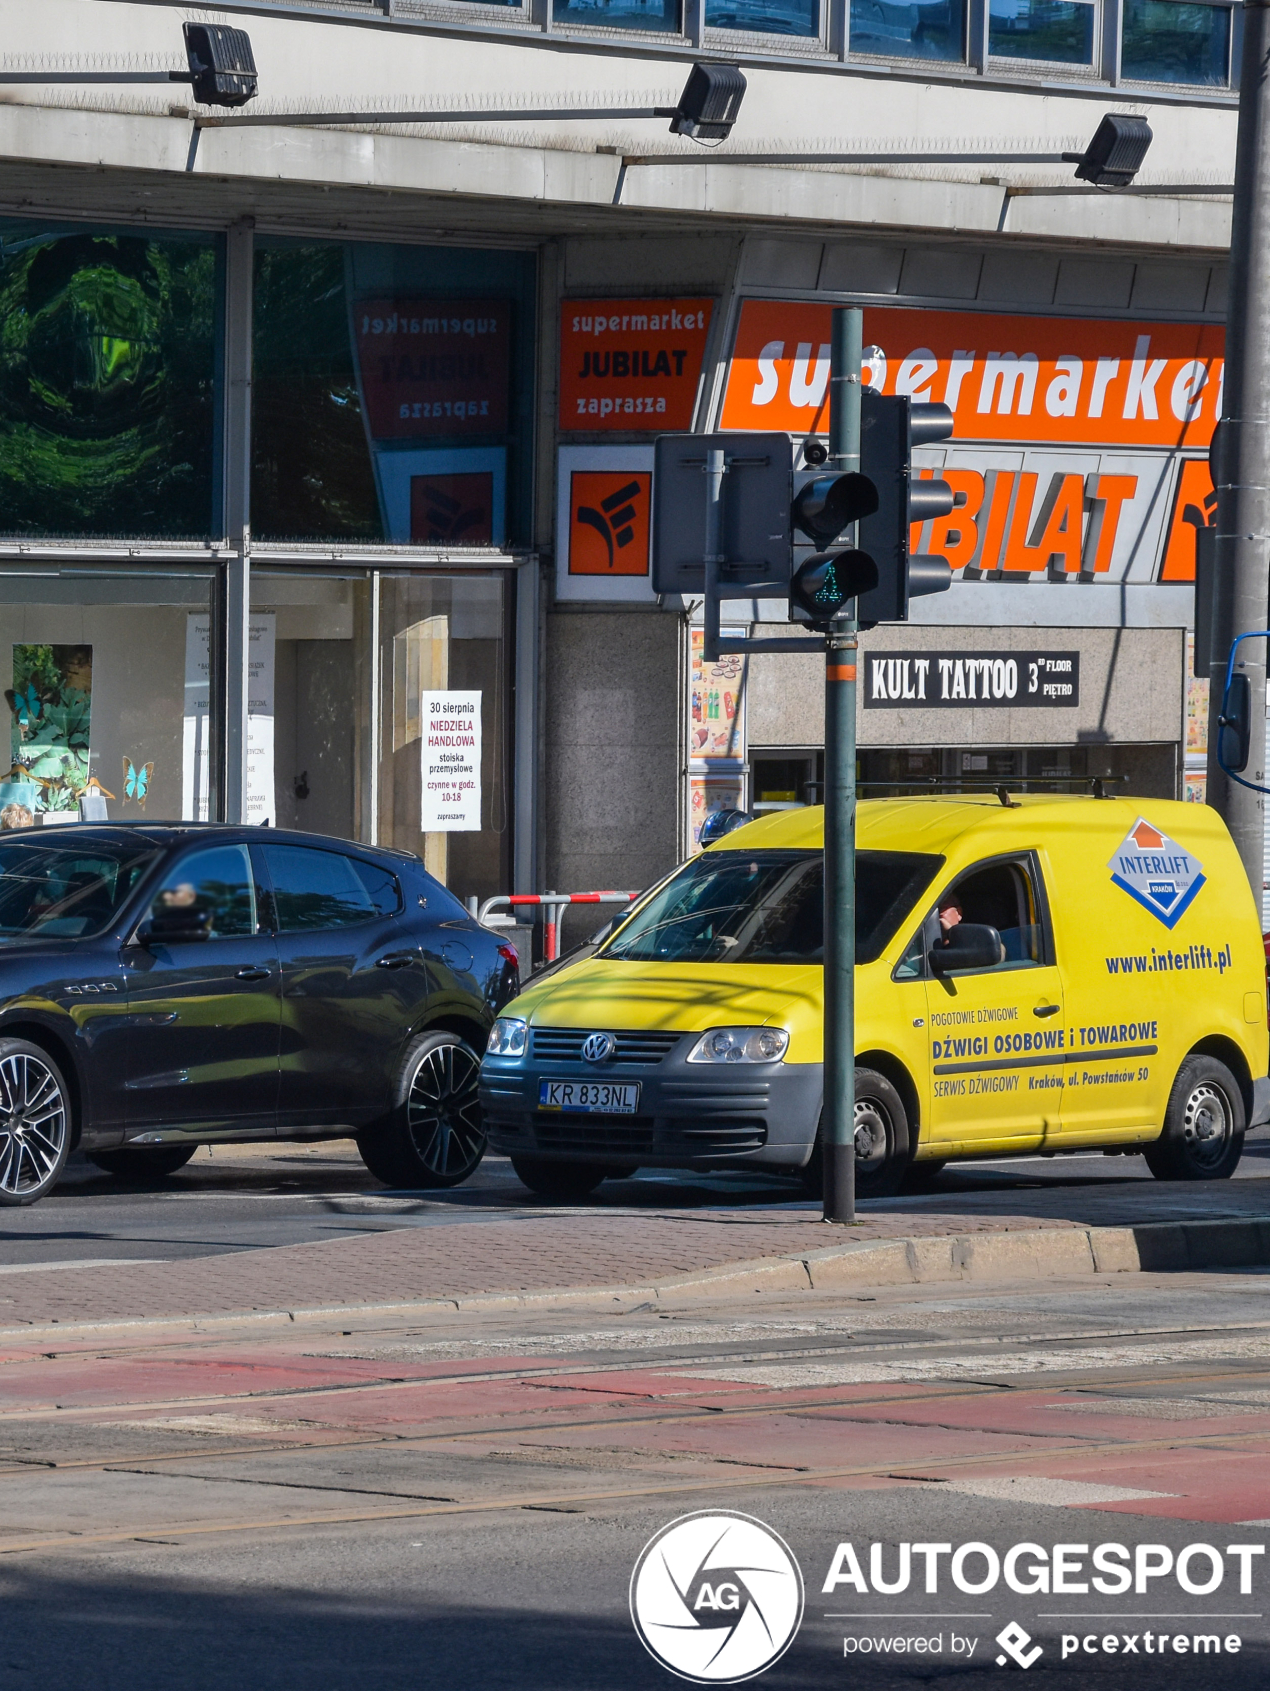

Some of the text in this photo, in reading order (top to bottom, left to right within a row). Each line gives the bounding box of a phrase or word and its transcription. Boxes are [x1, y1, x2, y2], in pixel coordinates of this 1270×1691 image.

[572, 309, 704, 336] supermarket
[578, 350, 687, 378] JUBILAT
[577, 397, 666, 418] zaprasza
[910, 468, 1138, 573] BILAT
[872, 659, 930, 700] KULT
[939, 659, 1018, 700] TATTOO
[1046, 660, 1072, 672] FLOOR
[1043, 684, 1072, 699] PIĘTRO
[430, 702, 474, 715] 30 sierpnia
[430, 720, 473, 731] NIEDZIELA
[428, 736, 475, 746] HANDLOWA
[439, 753, 464, 762] stoiska
[430, 764, 473, 775] przemysłowe
[427, 782, 450, 791] czynne
[458, 780, 476, 791] godz.
[442, 792, 461, 802] 10-18
[1119, 856, 1190, 874] INTERLIFT
[1151, 884, 1173, 893] KRAKÓW
[1105, 944, 1232, 974] www.interlift.pl
[931, 1006, 1018, 1026] POGOTOWIE DŹWIGOWE
[932, 1021, 1158, 1059] DŹWIGI OSOBOWE i TOWAROWE
[934, 1068, 1148, 1098] SERWIS DŹWIGOWY Kraków, ul. Powstańców 50
[550, 1084, 632, 1107] KR 833NL
